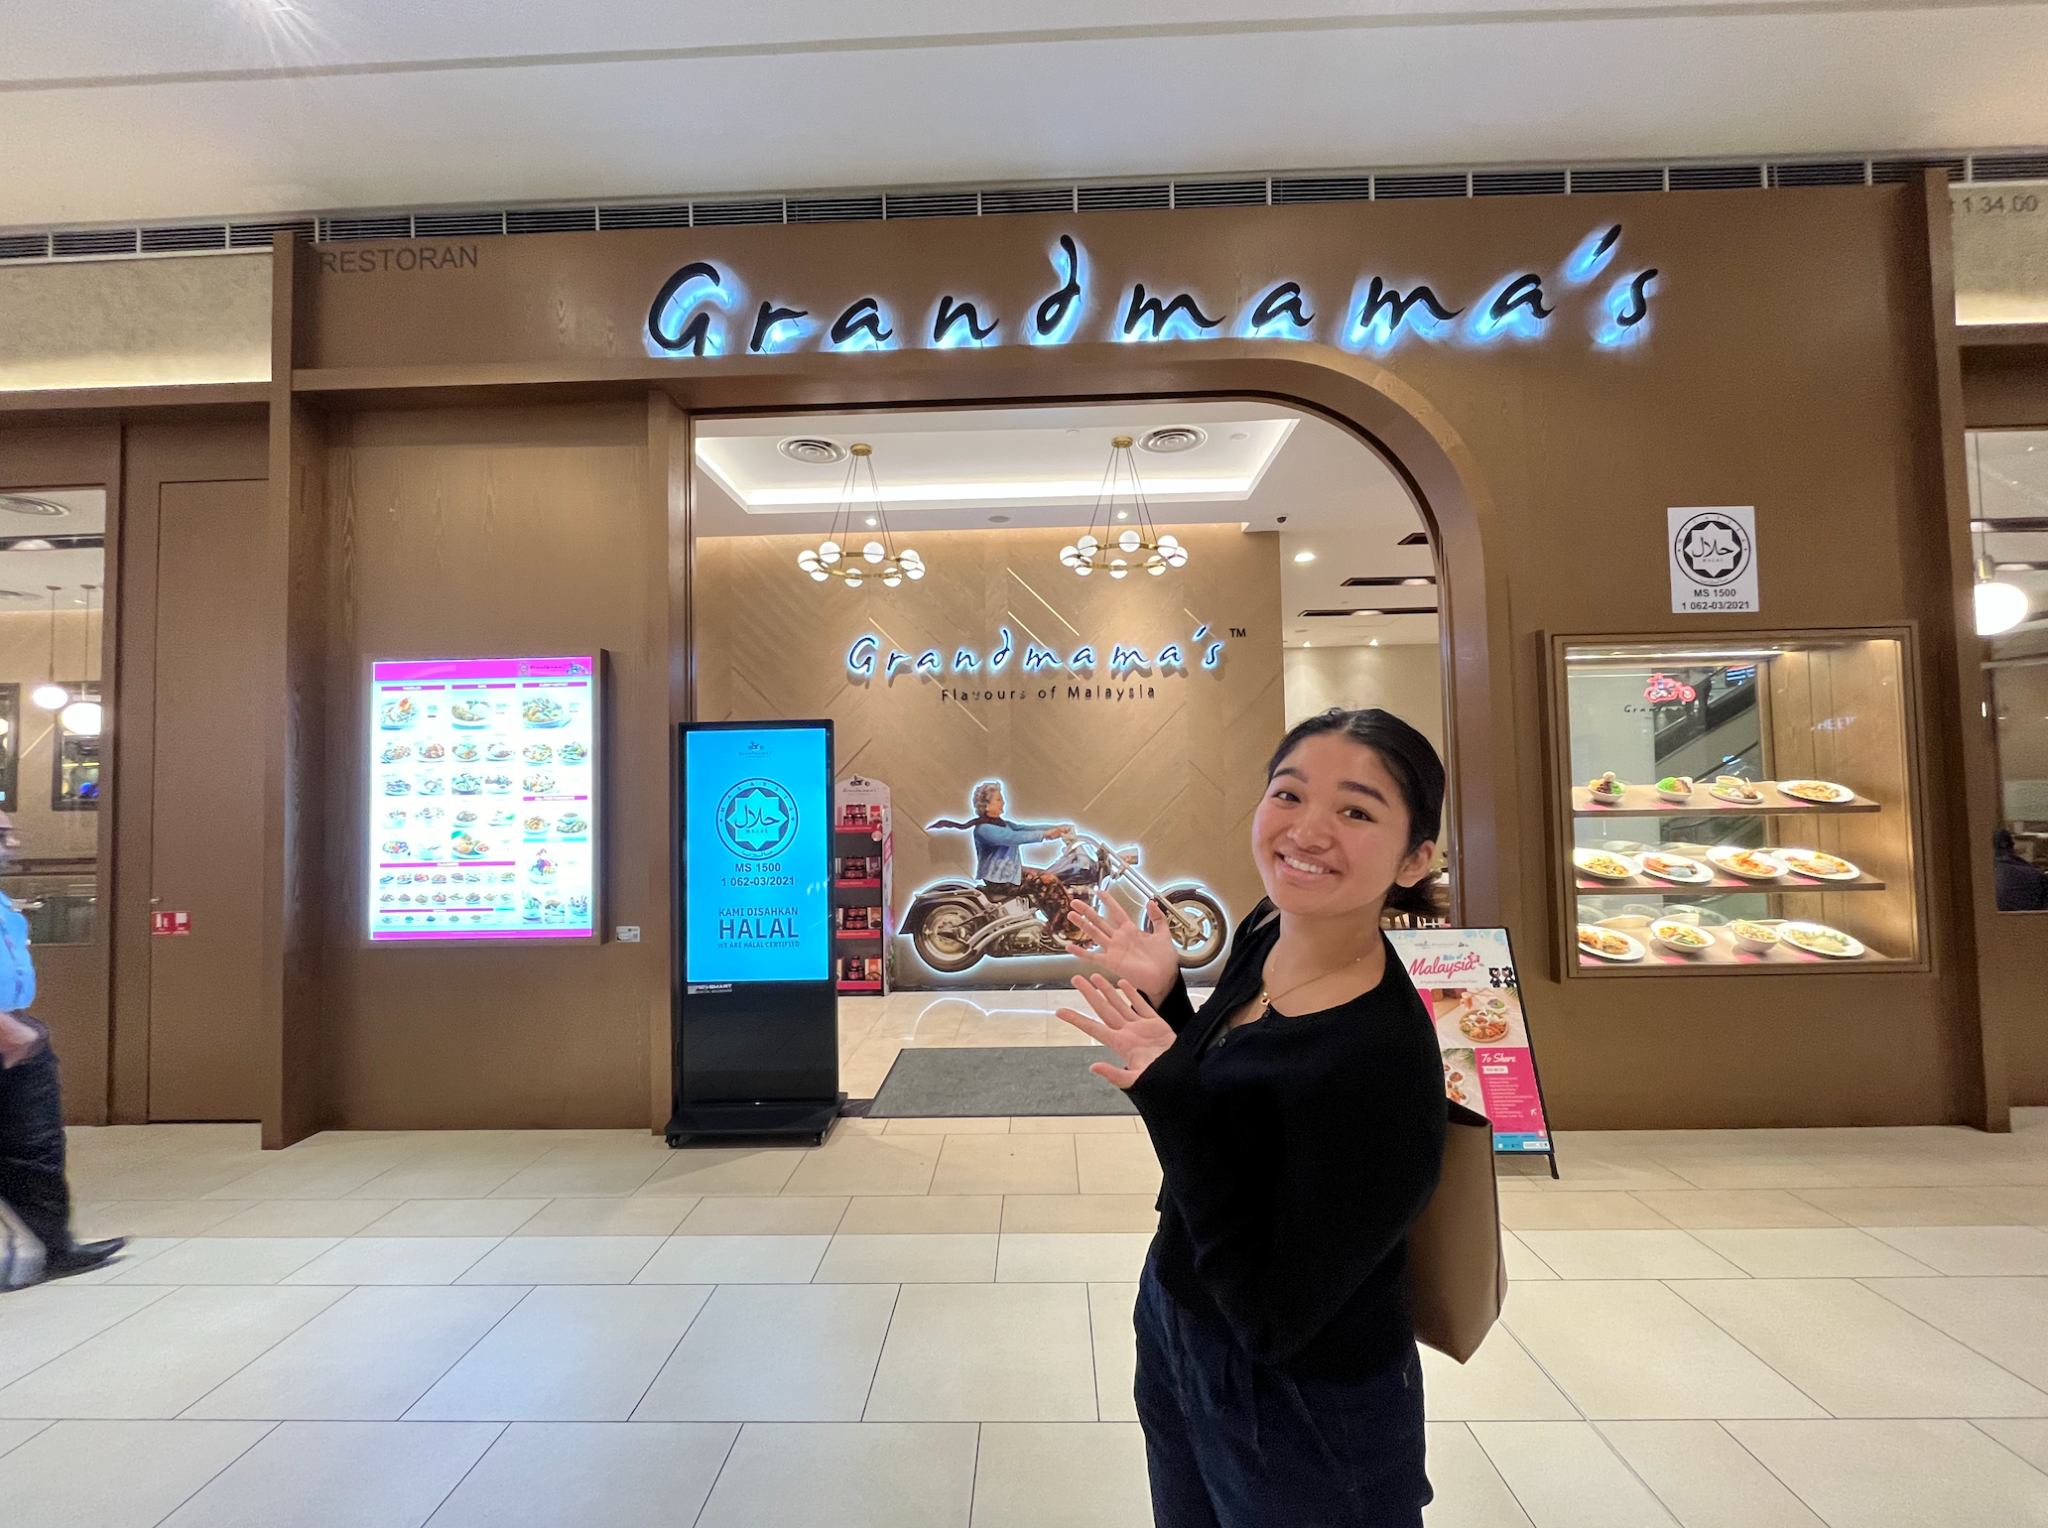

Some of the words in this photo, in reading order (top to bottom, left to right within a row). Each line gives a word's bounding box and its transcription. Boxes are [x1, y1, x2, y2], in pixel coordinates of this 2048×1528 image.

[320, 246, 478, 273] RESTORAN
[648, 225, 1658, 357] Grandmama's
[1694, 589, 1709, 597] MS
[1713, 589, 1736, 597] 1500
[1682, 602, 1686, 610] 1
[1690, 601, 1749, 610] 062-03/2021
[848, 626, 1224, 674] Grandmama's
[942, 688, 1026, 702] Flavours
[1038, 686, 1056, 699] of
[1068, 684, 1155, 702] Malaysia
[735, 804, 780, 828] حلال
[735, 863, 752, 872] MS
[756, 862, 781, 872] 1500
[721, 878, 727, 887] 1
[730, 876, 795, 887] 062-03/2021
[718, 908, 744, 916] KAMI
[747, 907, 798, 916] DISAHKAN
[719, 918, 799, 939] HALAL
[1408, 956, 1476, 979] Malaysia
[1481, 1053, 1492, 1063] To
[1493, 1052, 1516, 1063] Share
